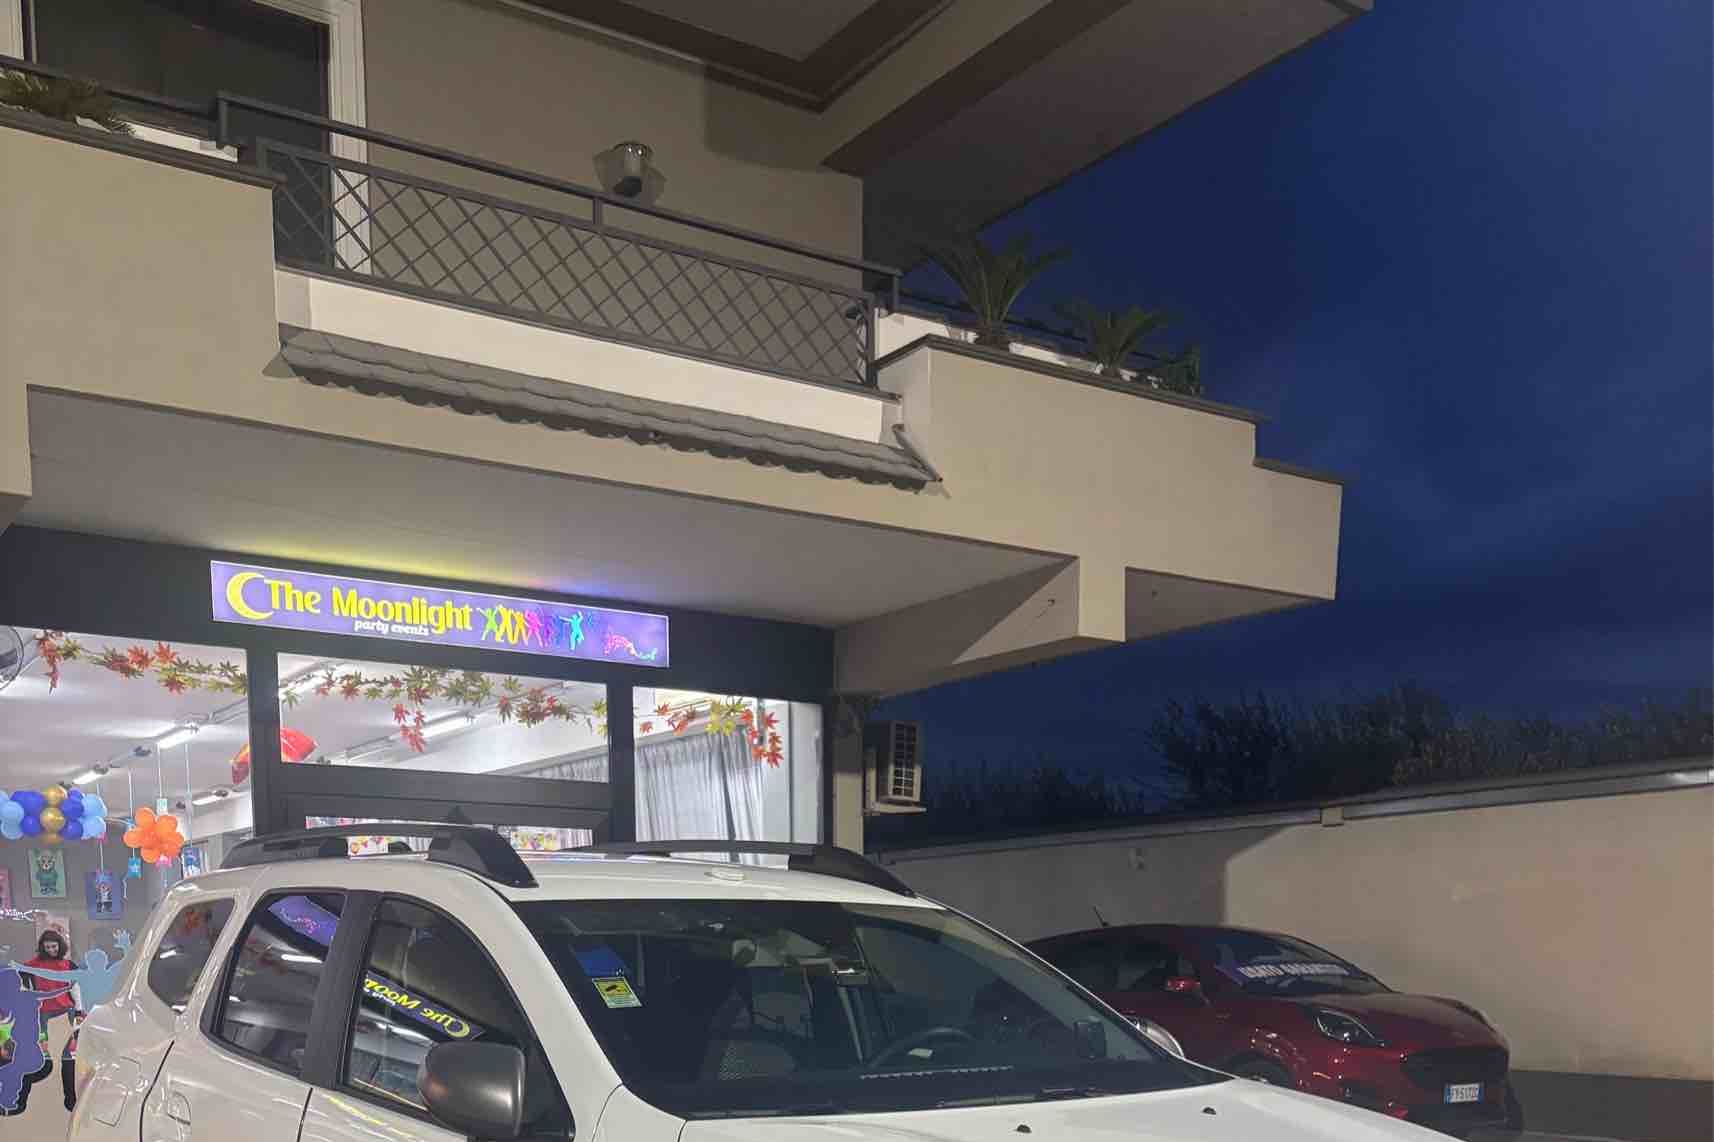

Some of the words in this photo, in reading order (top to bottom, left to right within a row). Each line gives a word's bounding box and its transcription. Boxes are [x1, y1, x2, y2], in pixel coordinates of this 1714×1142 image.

[264, 578, 321, 614] The
[331, 586, 473, 634] Moonlight
[354, 619, 389, 634] party
[390, 625, 429, 636] events
